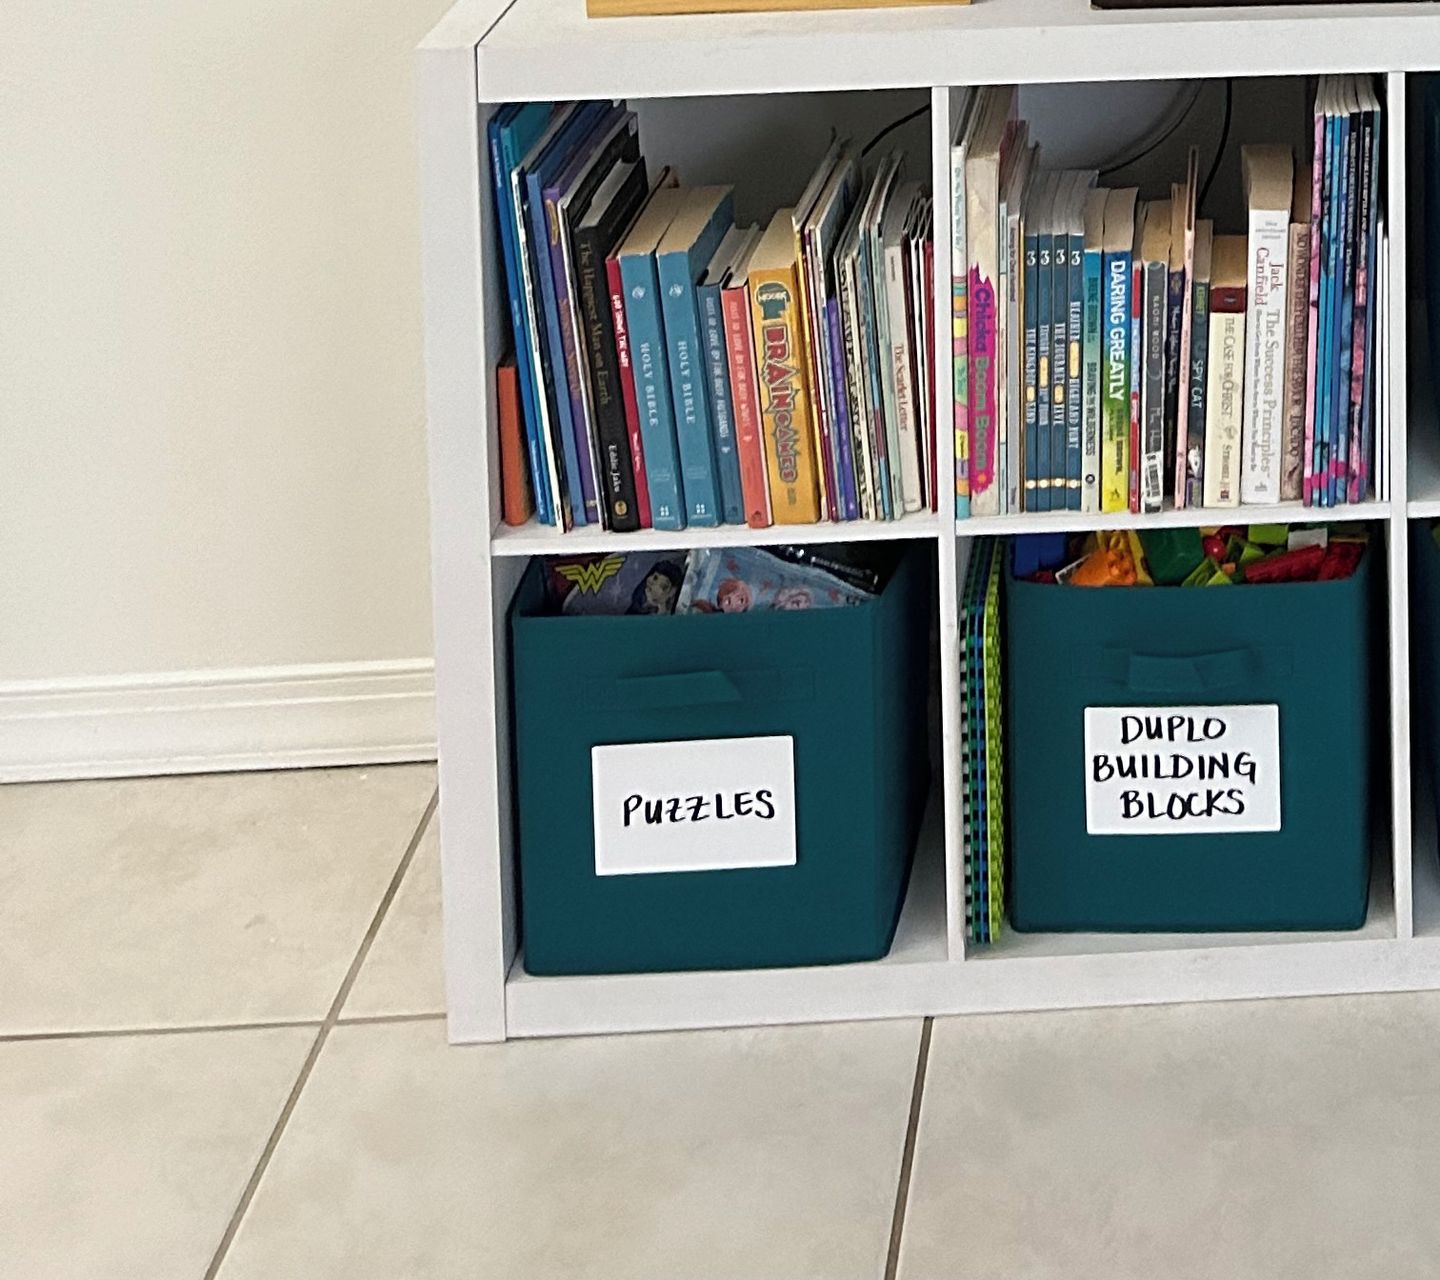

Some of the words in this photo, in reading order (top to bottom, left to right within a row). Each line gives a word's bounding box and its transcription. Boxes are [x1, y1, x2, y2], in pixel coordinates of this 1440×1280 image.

[1025, 250, 1037, 266] 3
[1039, 250, 1050, 265] 3
[1054, 249, 1066, 265] 3
[1070, 250, 1082, 266] 3
[1109, 259, 1127, 325] DARING
[1254, 247, 1270, 306] Canfield
[1268, 261, 1285, 292] Jack
[975, 287, 992, 353] Chicka
[1151, 295, 1161, 326] NAOMI
[1225, 317, 1235, 335] THE
[1265, 308, 1281, 337] The
[638, 342, 654, 379] HOLY
[677, 341, 691, 378] HOLY
[893, 343, 905, 359] The
[1108, 327, 1126, 401] GREATLY
[1223, 335, 1237, 361] CASE
[760, 323, 802, 414] BRAIN
[893, 360, 909, 400] Scarlet
[974, 356, 990, 410] Boom
[1191, 359, 1204, 381] SPY
[1223, 363, 1234, 380] FOR
[1263, 340, 1280, 396] Success
[645, 384, 659, 427] BIBLE
[682, 383, 696, 425] BIBLE
[1190, 387, 1204, 409] CAT
[1221, 381, 1236, 419] CHRIST
[897, 401, 910, 432] Letter
[1085, 406, 1097, 456] WILDERNESS
[608, 445, 620, 469] Eddie
[770, 413, 802, 483] GAMES
[974, 415, 990, 470] Boom
[1121, 714, 1227, 745] DUPLO
[1092, 751, 1257, 784] BUILDING
[622, 789, 776, 827] PUZZLES
[1118, 788, 1246, 820] BLOCKS
